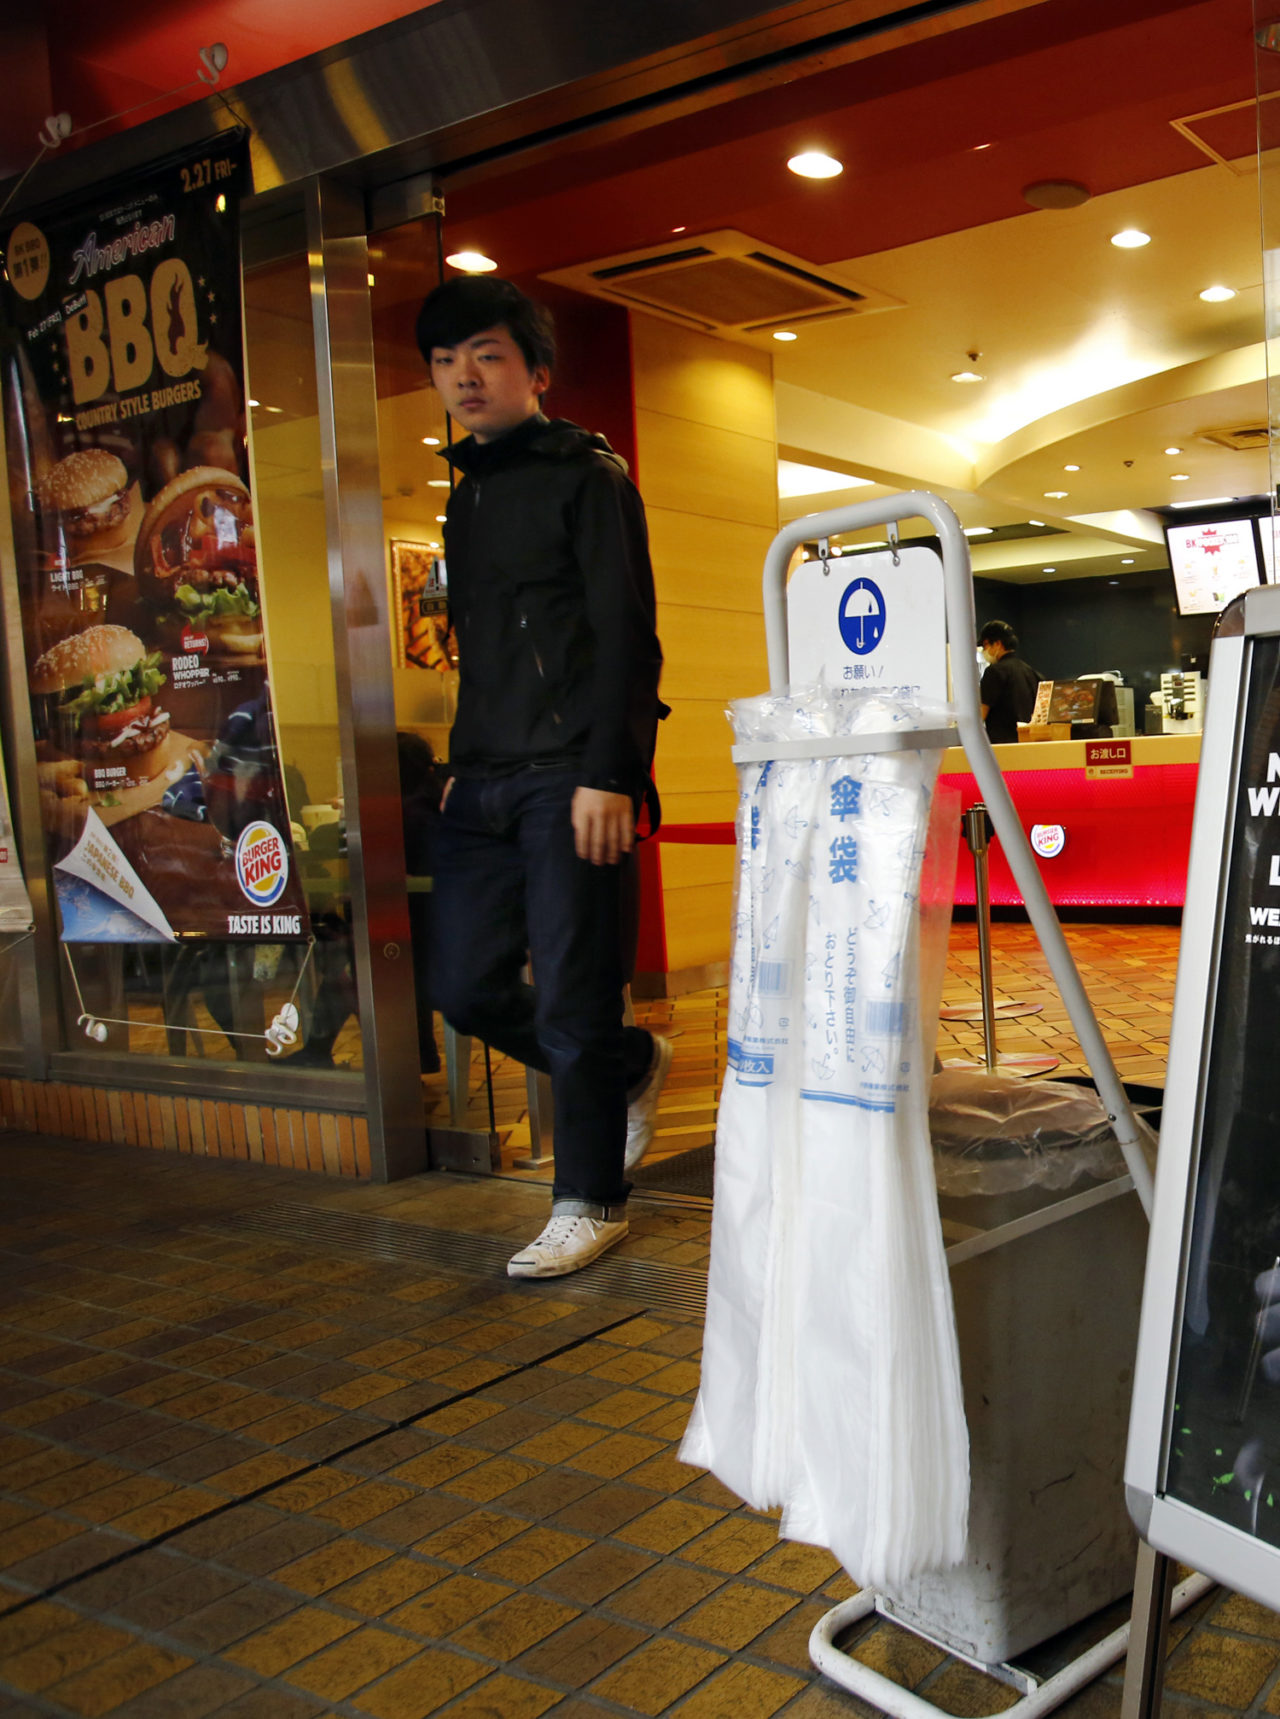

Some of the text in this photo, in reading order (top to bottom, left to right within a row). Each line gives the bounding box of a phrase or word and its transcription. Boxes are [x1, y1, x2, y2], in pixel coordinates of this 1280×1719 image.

[180, 159, 212, 193] 2.27
[69, 214, 175, 285] American
[62, 258, 209, 405] BBQ
[76, 379, 202, 431] COUNTRY STYLE BURGERS
[172, 654, 199, 671] RODEO
[173, 668, 210, 681] WHOPPER
[1090, 747, 1126, 760] お渡し口
[828, 775, 863, 884] 傘袋
[1038, 833, 1059, 848] KING
[242, 837, 279, 867] BURGER
[245, 851, 281, 888] KING
[228, 915, 301, 934] TASTE IS KING
